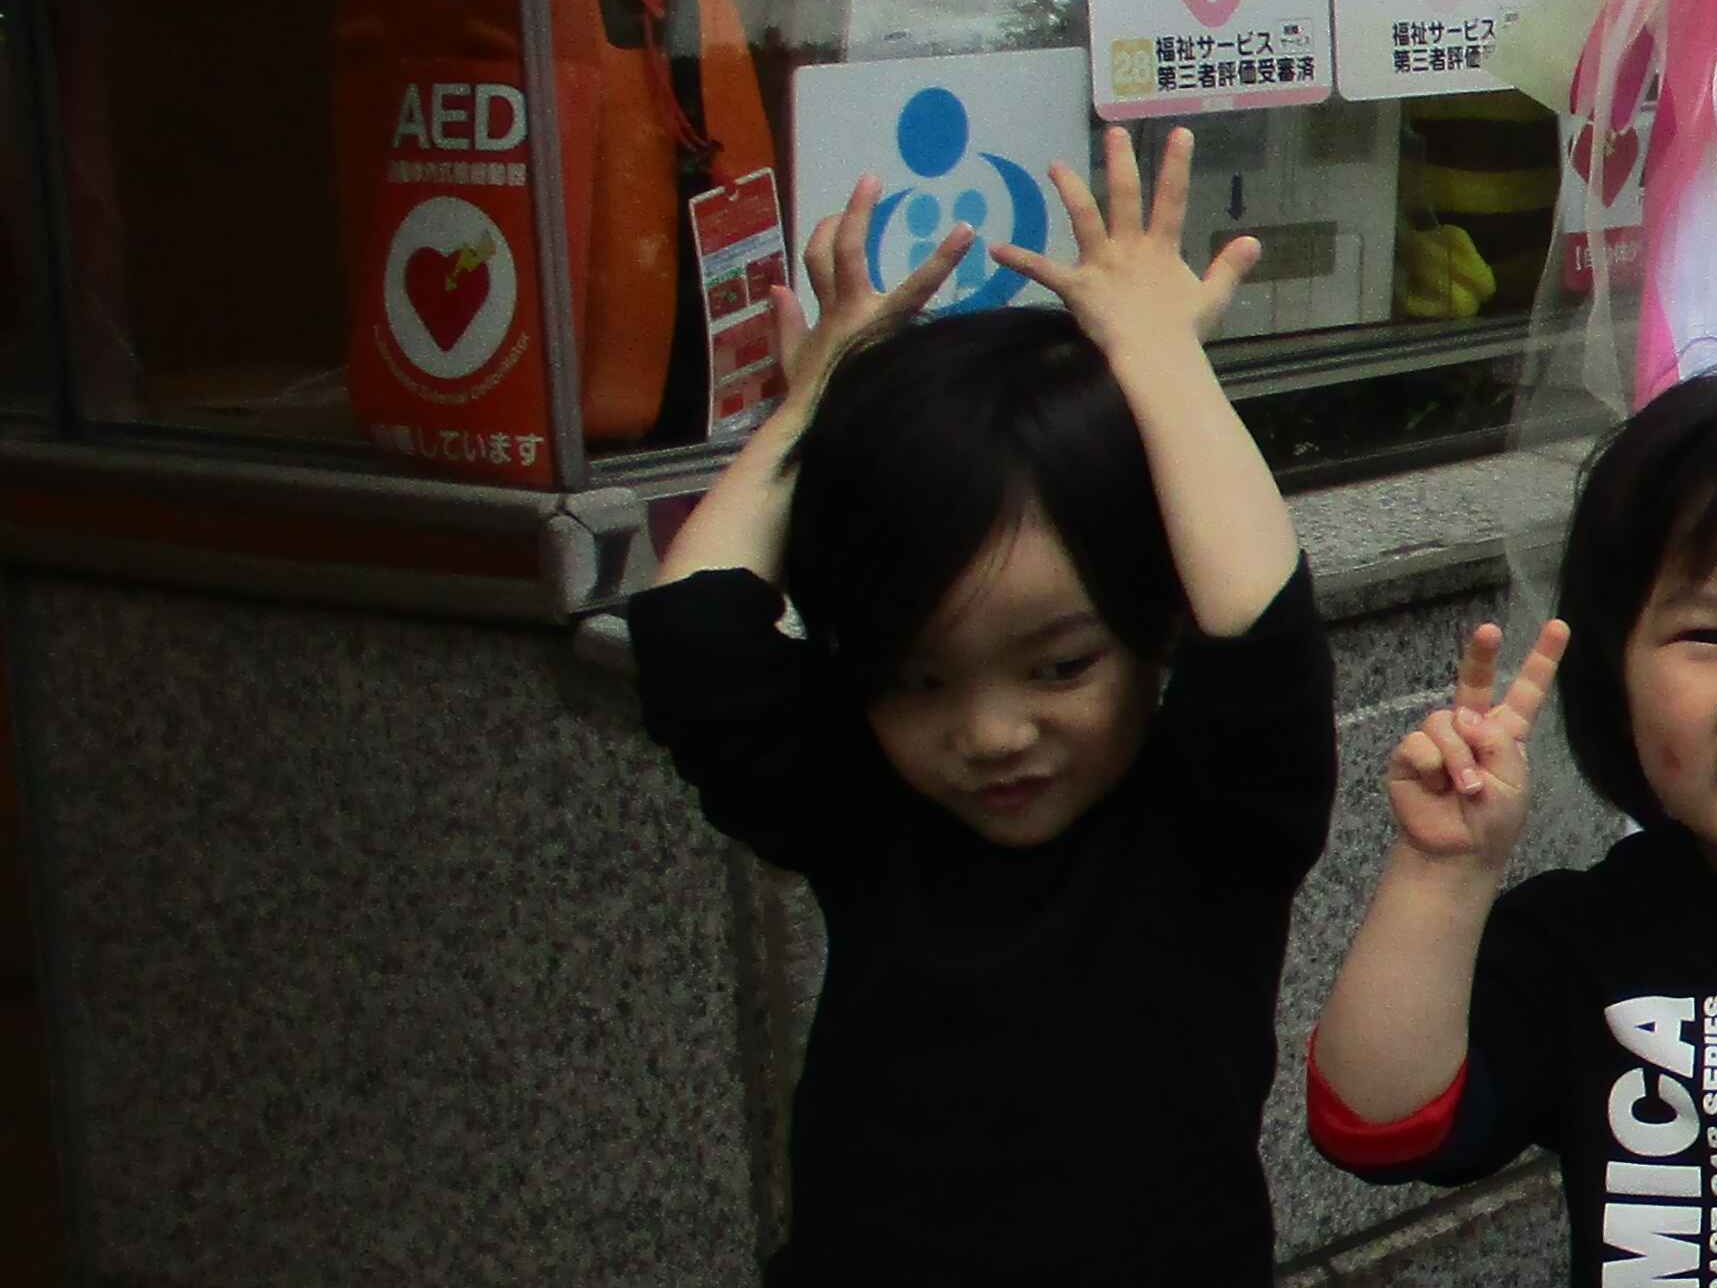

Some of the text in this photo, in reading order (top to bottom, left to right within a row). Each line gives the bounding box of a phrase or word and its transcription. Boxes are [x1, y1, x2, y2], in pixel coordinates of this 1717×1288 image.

[1155, 30, 1275, 63] 福祉サービス
[1392, 18, 1496, 48] 福祉サービス
[1157, 56, 1316, 92] 第三者評価受審済
[393, 83, 528, 152] AED
[369, 423, 545, 468] しています
